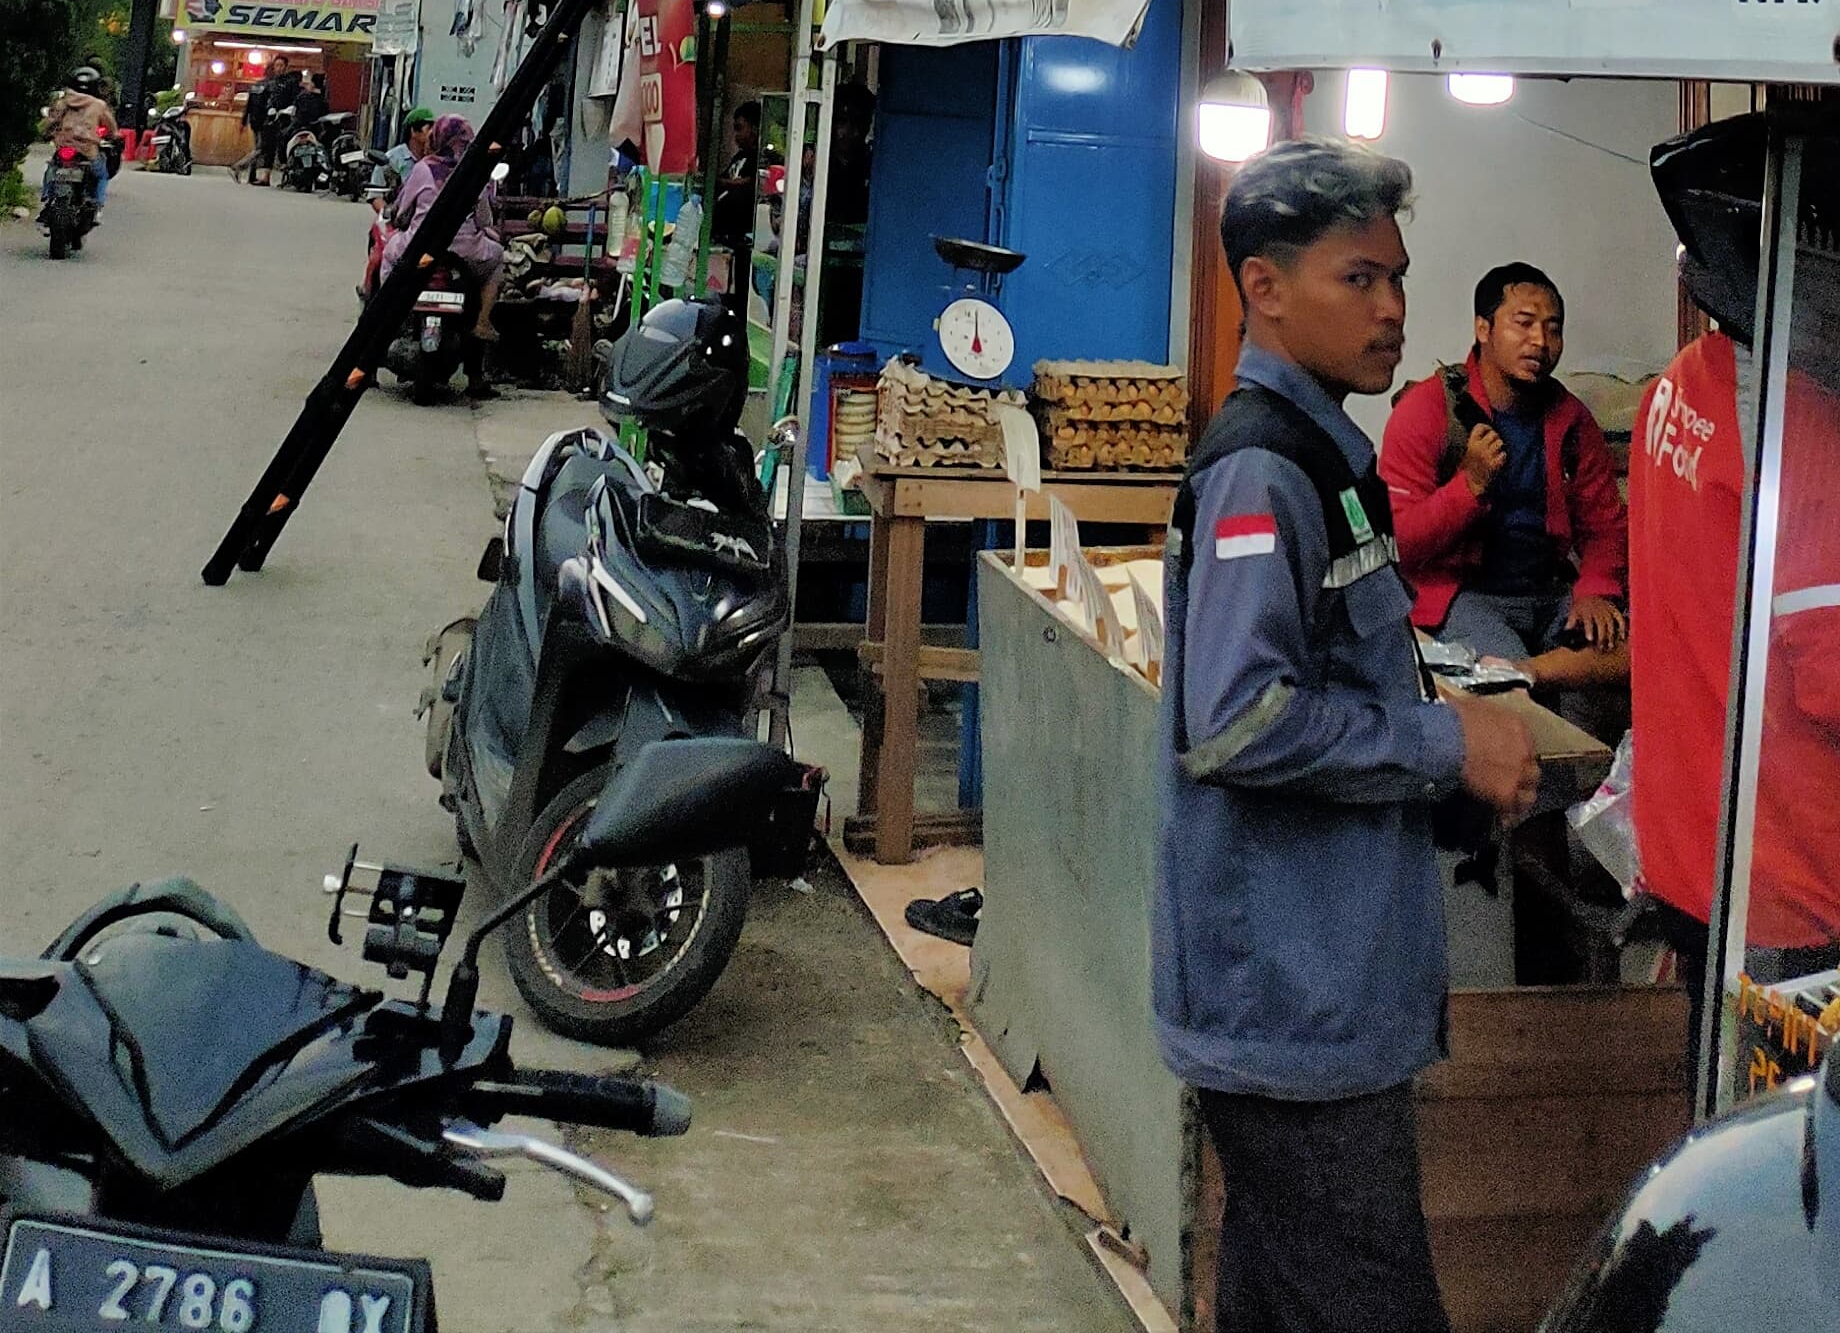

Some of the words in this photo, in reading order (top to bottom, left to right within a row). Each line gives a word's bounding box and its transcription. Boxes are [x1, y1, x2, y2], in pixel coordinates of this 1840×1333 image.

[223, 4, 377, 34] SEMAR
[17, 1248, 52, 1310] A
[99, 1259, 256, 1333] 2786
